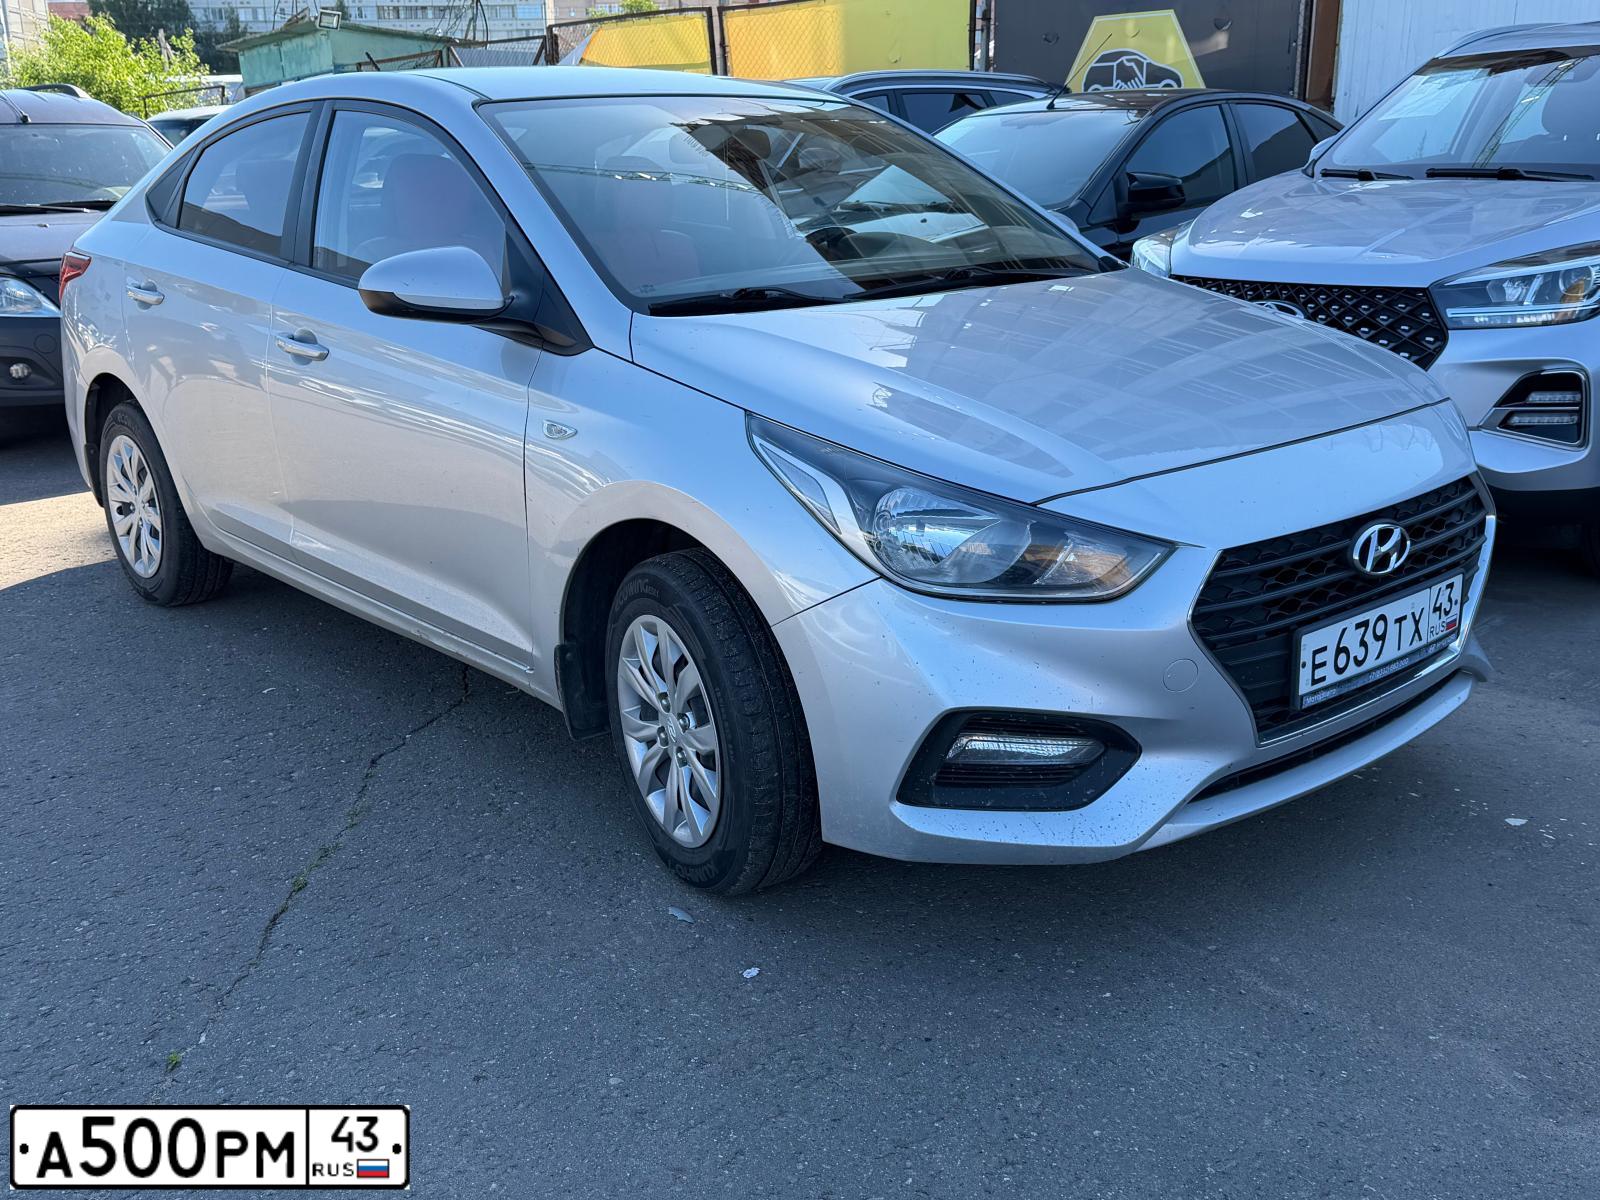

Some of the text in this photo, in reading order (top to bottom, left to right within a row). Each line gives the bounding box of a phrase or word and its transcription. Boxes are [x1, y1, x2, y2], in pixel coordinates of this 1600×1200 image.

[1310, 607, 1425, 687] Е639ТХ
[1431, 581, 1455, 620] 43
[1429, 620, 1446, 639] RUS
